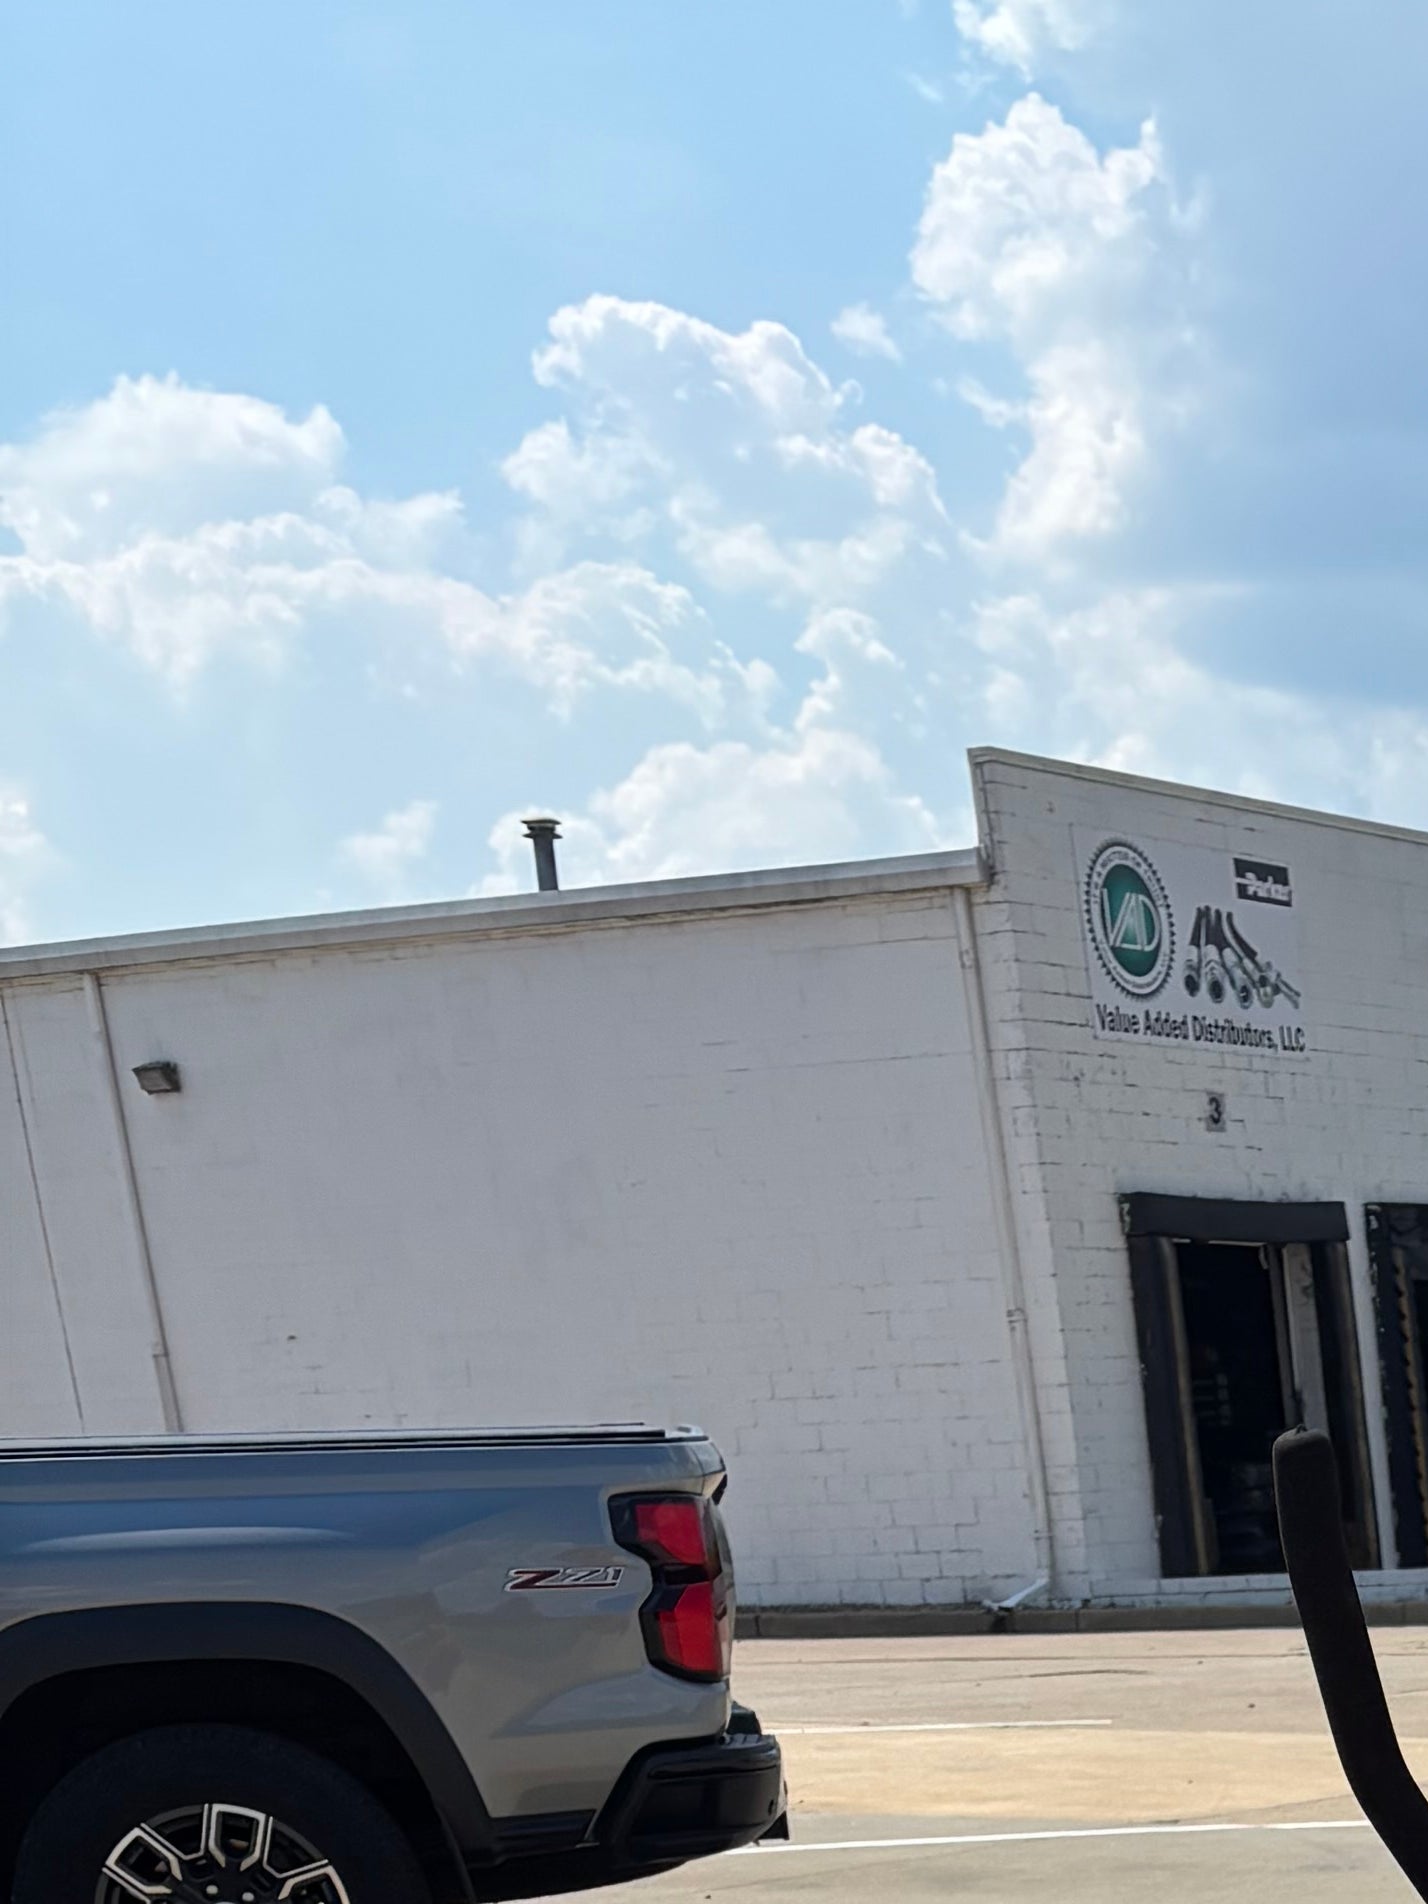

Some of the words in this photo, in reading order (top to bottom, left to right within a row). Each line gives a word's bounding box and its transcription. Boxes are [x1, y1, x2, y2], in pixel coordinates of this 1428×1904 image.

[1095, 1003, 1140, 1034] Value
[1144, 1009, 1189, 1040] Added
[1191, 1015, 1278, 1054] Distributors,
[1279, 1025, 1307, 1053] LLC
[1207, 1095, 1223, 1125] 3
[504, 1567, 625, 1592] Z71
